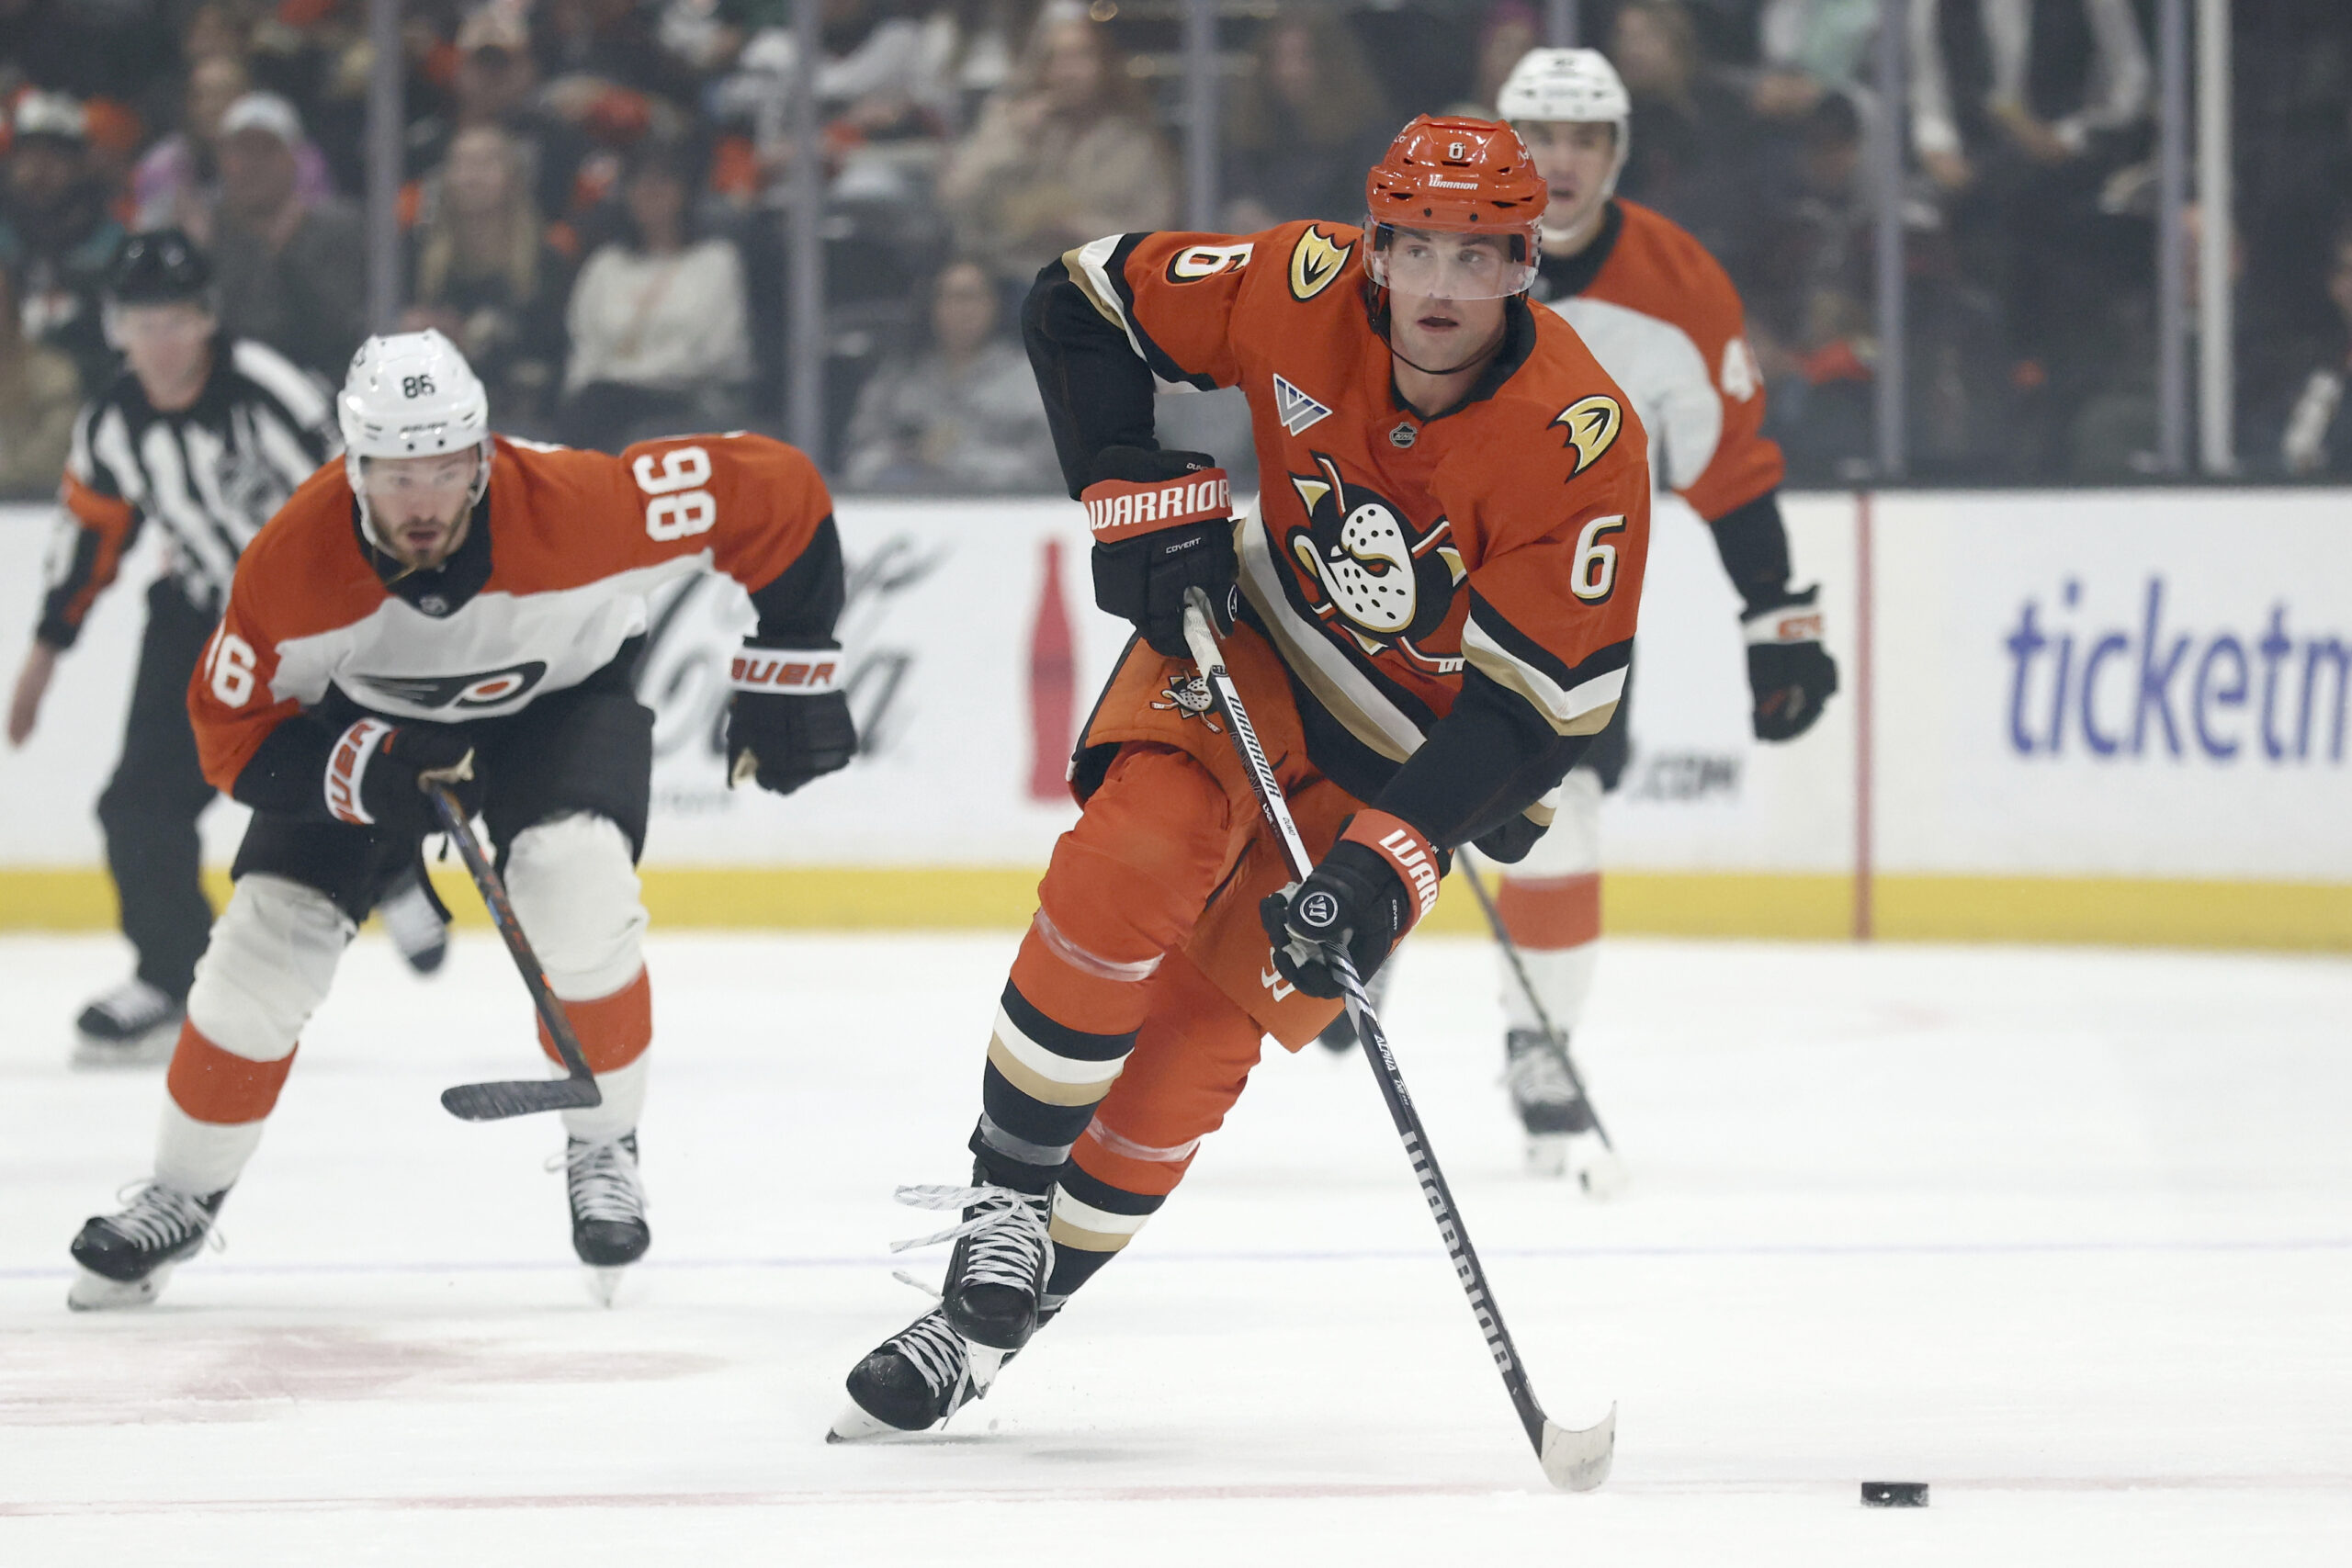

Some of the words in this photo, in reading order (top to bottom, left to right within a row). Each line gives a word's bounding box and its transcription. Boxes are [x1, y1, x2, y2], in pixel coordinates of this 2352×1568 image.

[1448, 141, 1465, 160] 6
[1165, 243, 1255, 285] 6
[401, 373, 435, 400] 86
[632, 446, 716, 542] 86
[1089, 479, 1233, 531] WARRIOR
[1166, 536, 1202, 554] COVERT
[1570, 514, 1626, 605] 6
[1228, 695, 1281, 798] WARRIOR
[1374, 1033, 1397, 1071] ALPHA
[1402, 1131, 1512, 1373] WARRIOR
